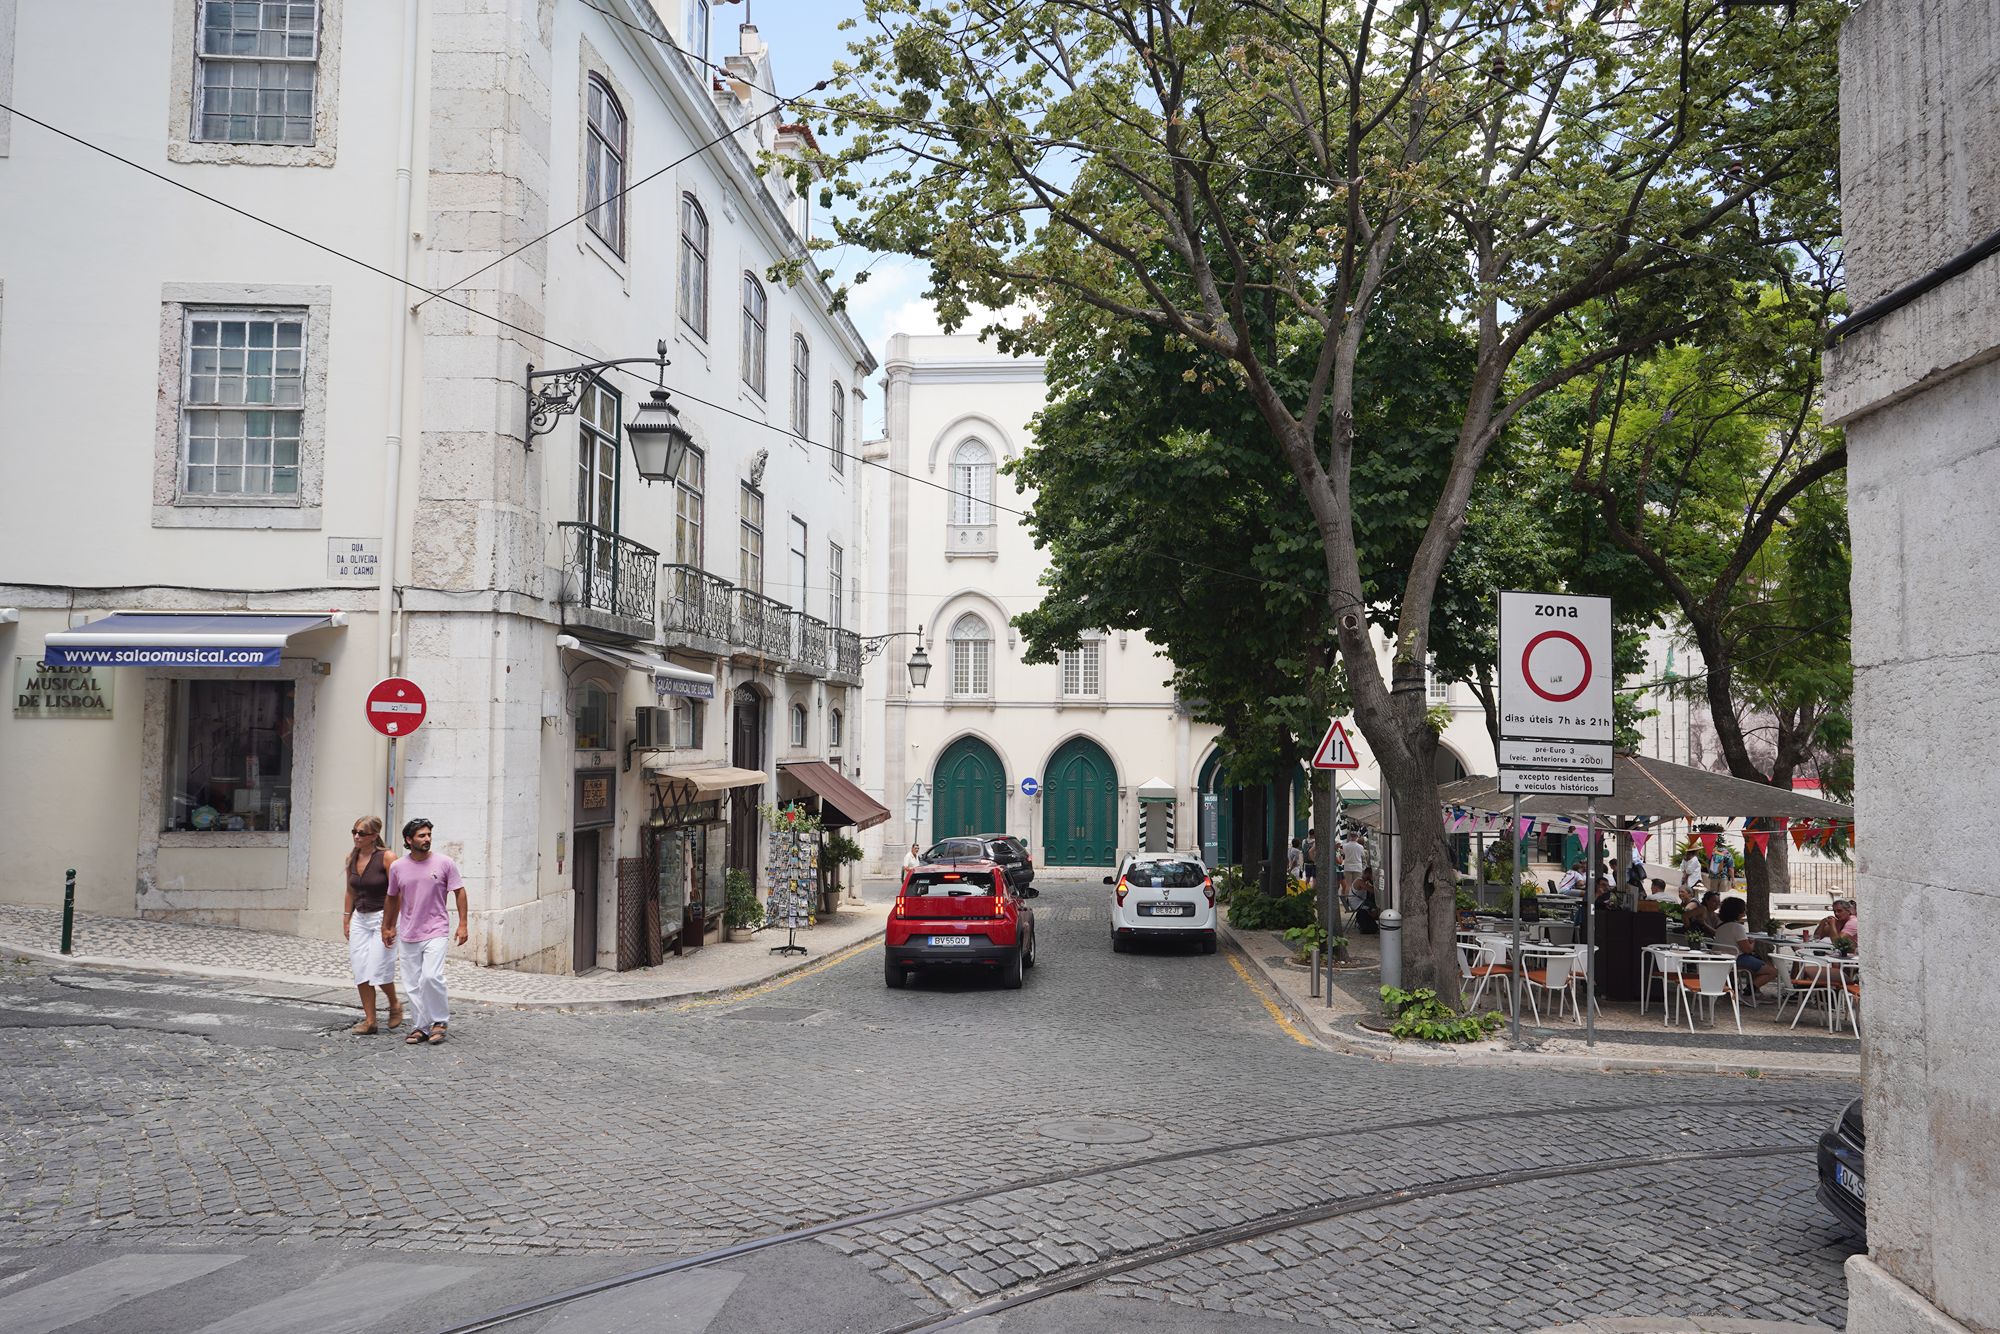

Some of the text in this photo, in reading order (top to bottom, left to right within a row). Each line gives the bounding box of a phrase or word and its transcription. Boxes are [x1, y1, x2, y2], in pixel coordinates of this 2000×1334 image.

[351, 543, 364, 552] RUA
[336, 554, 378, 564] DA OLIVEIRA
[340, 566, 374, 576] AO CARMO
[1534, 604, 1578, 618] zona
[64, 649, 264, 664] www.salaomusical.com
[26, 677, 102, 691] MUSICAL
[657, 678, 672, 692] SALÃO
[673, 681, 691, 694] MUSICAL
[18, 694, 105, 708] DE LISBOA
[1504, 713, 1610, 727] dias úteis 7h às 21h
[1569, 747, 1575, 755] 3
[1532, 755, 1568, 764] anteriores
[1518, 773, 1596, 783] excepto residentes
[1560, 783, 1599, 792] históricos
